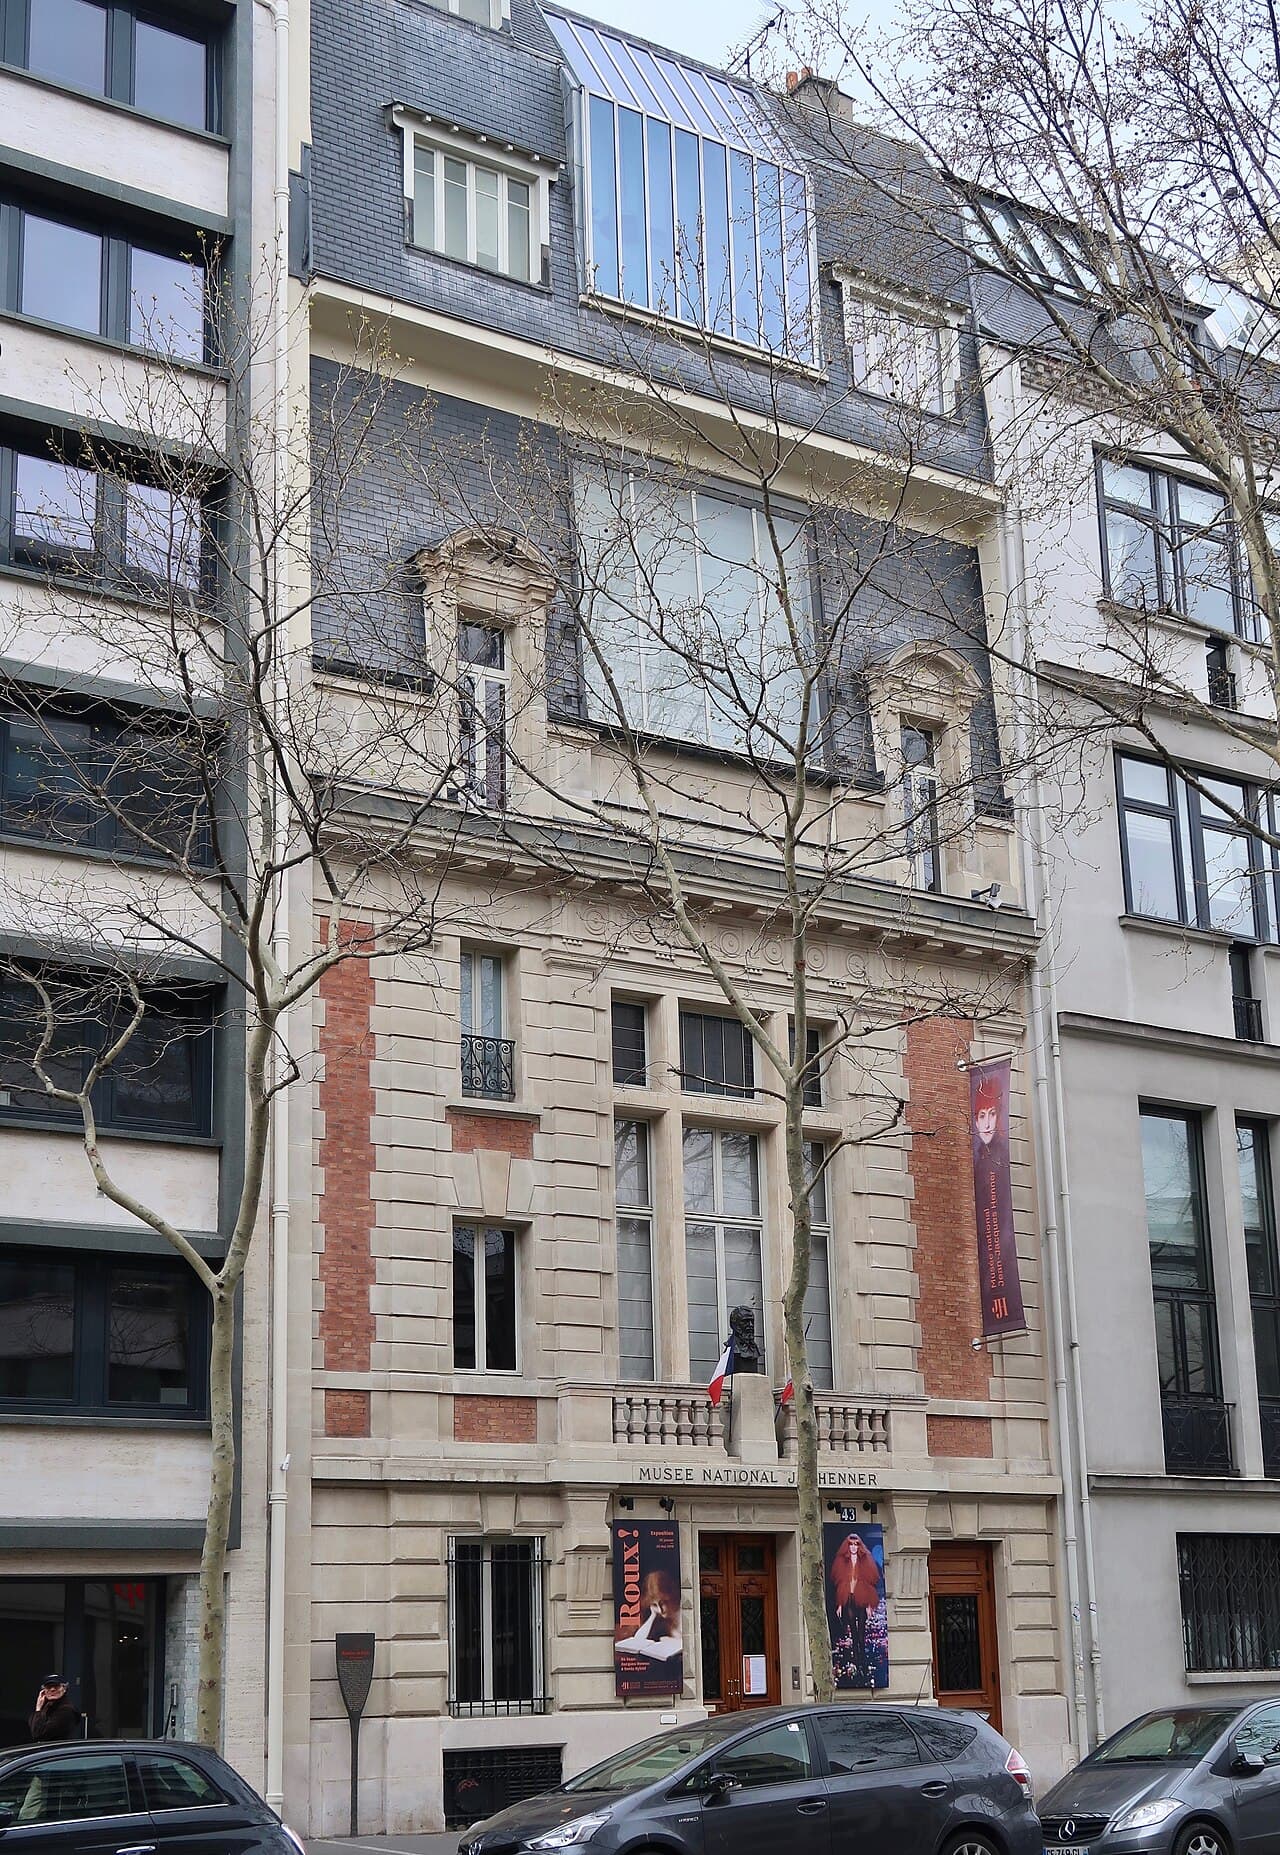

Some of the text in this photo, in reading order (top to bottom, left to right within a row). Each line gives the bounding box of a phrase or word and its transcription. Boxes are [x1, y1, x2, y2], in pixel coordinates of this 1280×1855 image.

[984, 1208, 993, 1251] national
[990, 1170, 1005, 1287] Jean-Jacques Henner
[639, 1467, 694, 1481] MUSEE
[702, 1468, 778, 1484] NATIONAL
[818, 1472, 878, 1486] HENNER
[841, 1508, 856, 1521] 43
